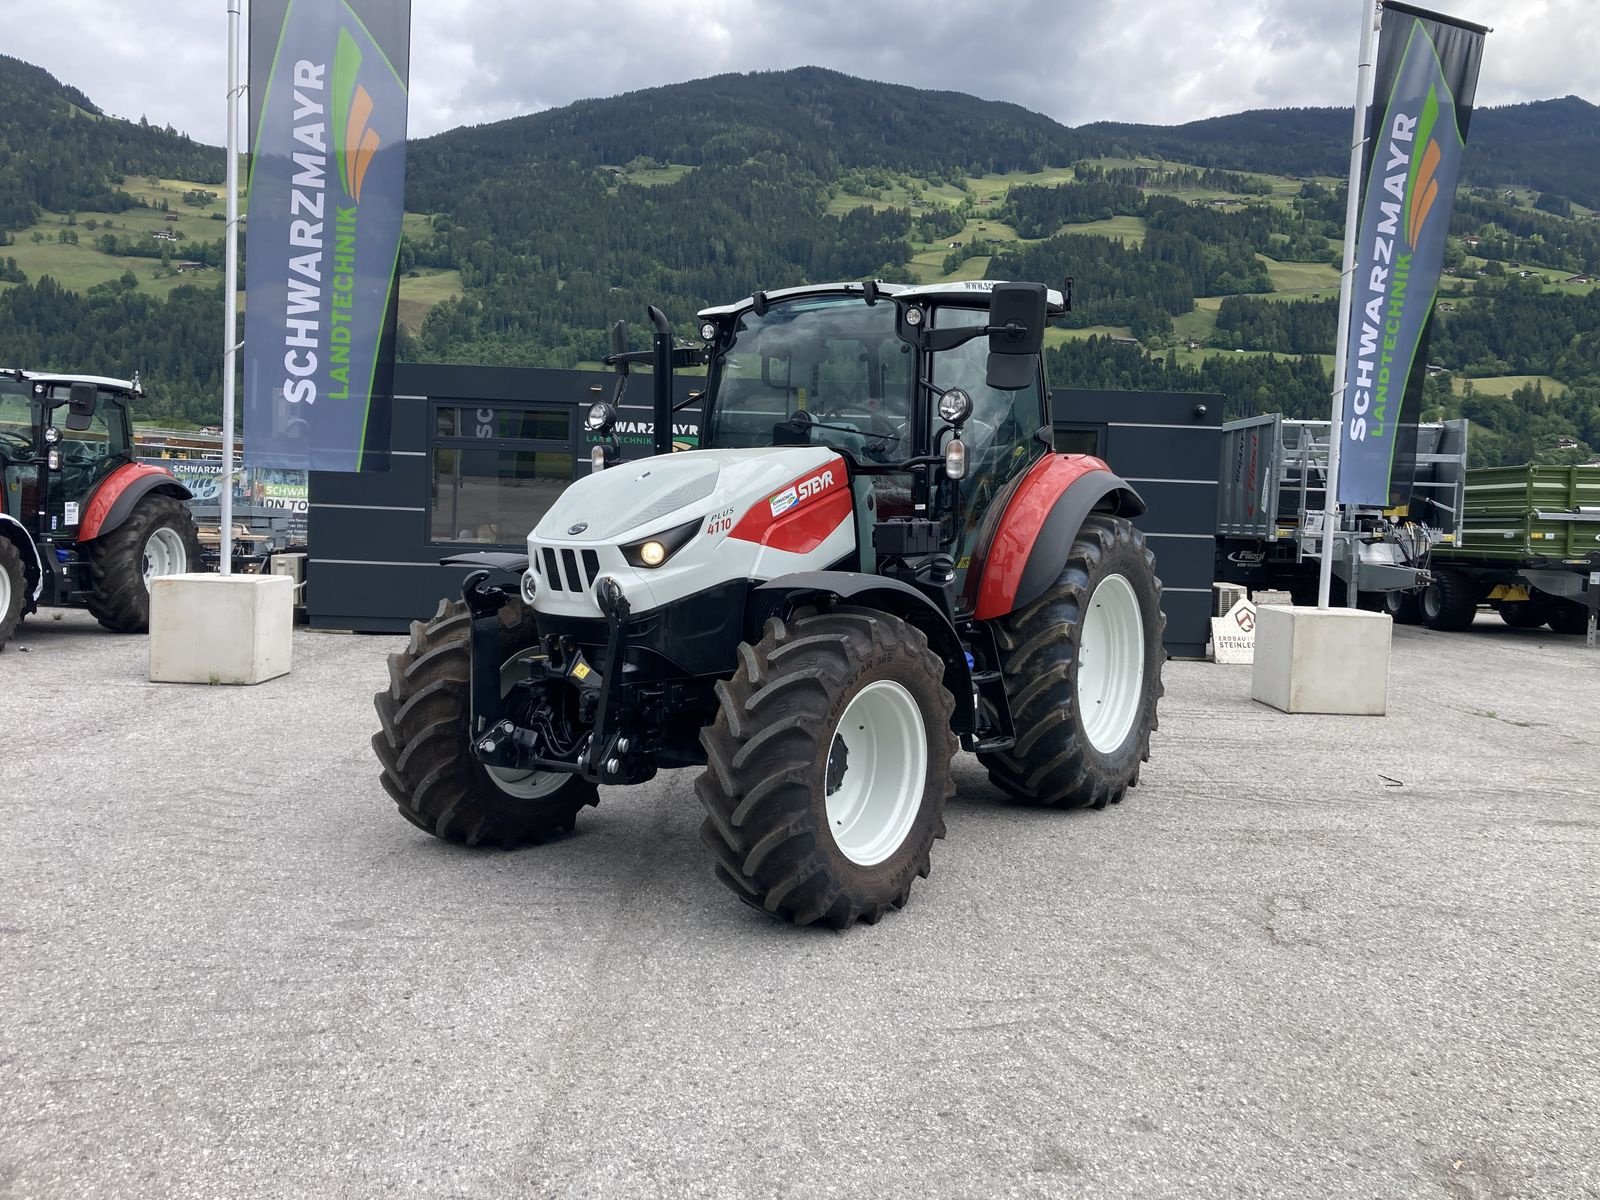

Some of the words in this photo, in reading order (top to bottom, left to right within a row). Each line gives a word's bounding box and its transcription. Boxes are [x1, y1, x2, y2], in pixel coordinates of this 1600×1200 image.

[283, 60, 326, 404] SCHWARZMAYR
[1350, 113, 1417, 441] SCHWARZMAYR
[329, 205, 357, 399] LANDTECHNIK
[1371, 252, 1413, 437] LANDTECHNIK
[266, 499, 285, 508] ON
[707, 517, 732, 535] 4110
[710, 506, 734, 522] PLUS
[798, 470, 834, 501] STEYR
